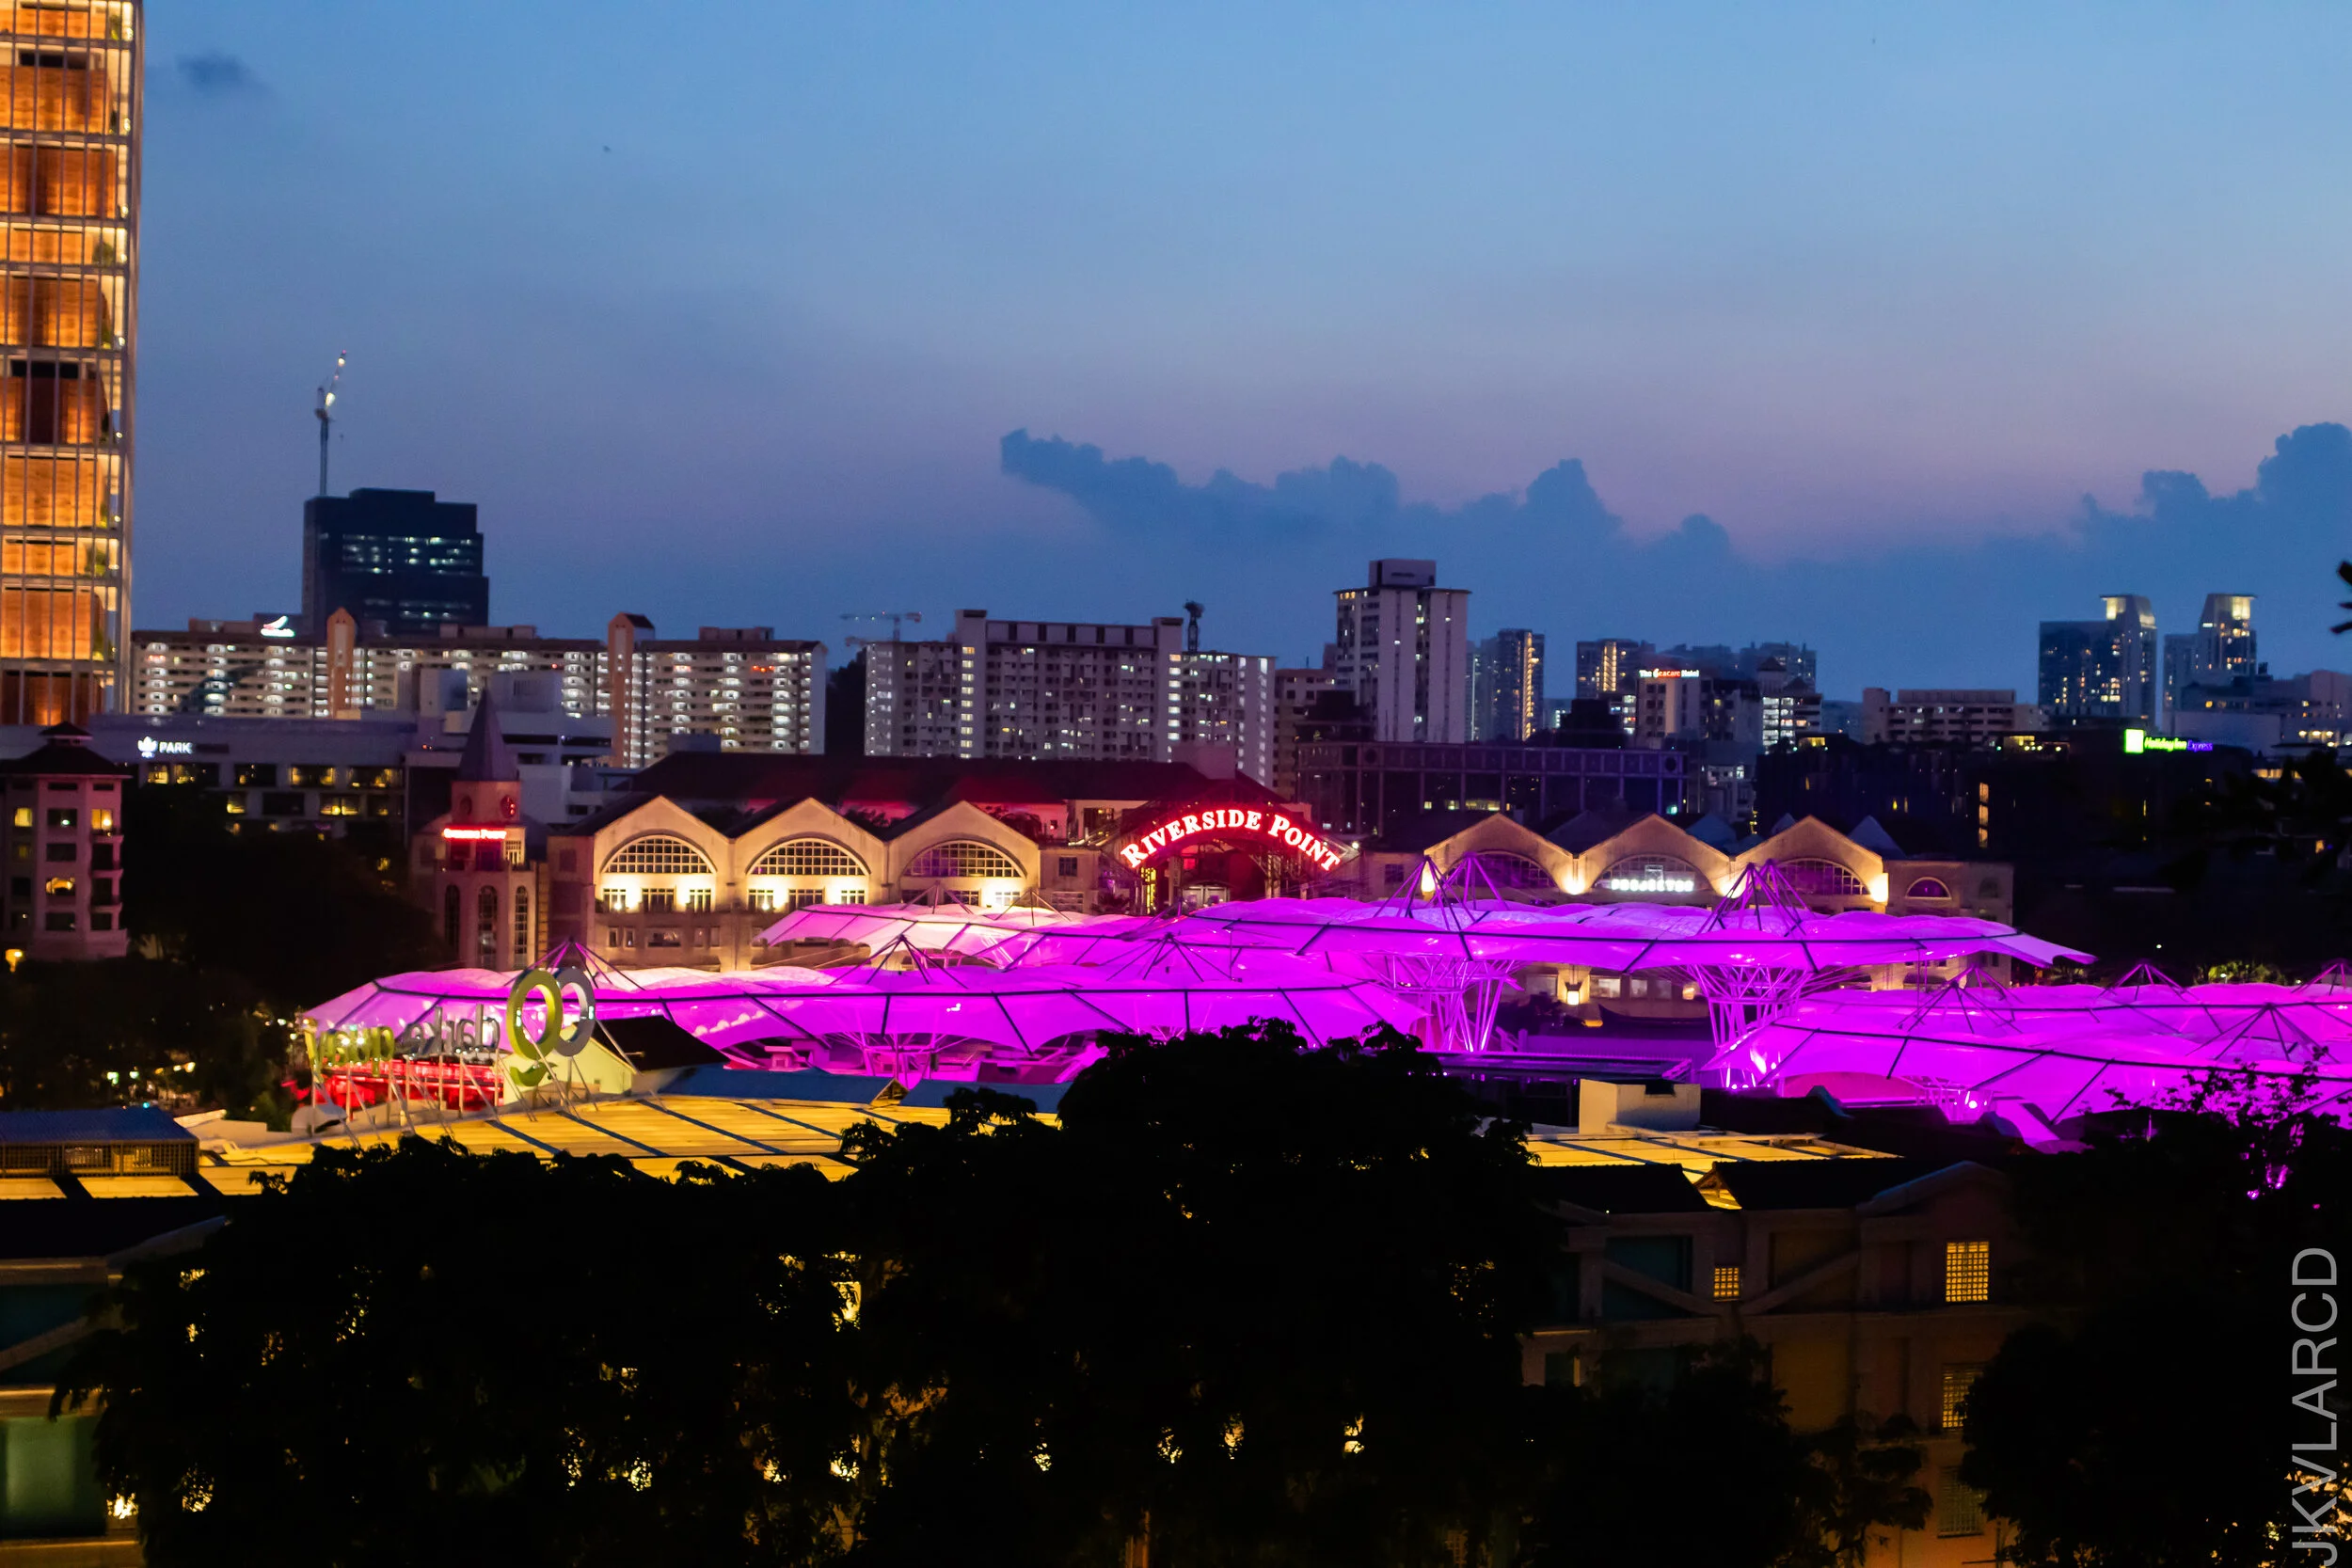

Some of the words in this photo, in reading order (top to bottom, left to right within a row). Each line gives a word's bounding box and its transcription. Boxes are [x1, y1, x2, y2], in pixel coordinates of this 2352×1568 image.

[1681, 670, 1699, 678] Hotel
[159, 741, 194, 754] PARK
[2144, 737, 2174, 752] Holiday
[2174, 737, 2187, 750] Inn
[2187, 739, 2214, 752] Express
[1120, 809, 1263, 869] RIVERSIDE
[1267, 814, 1342, 872] POINT
